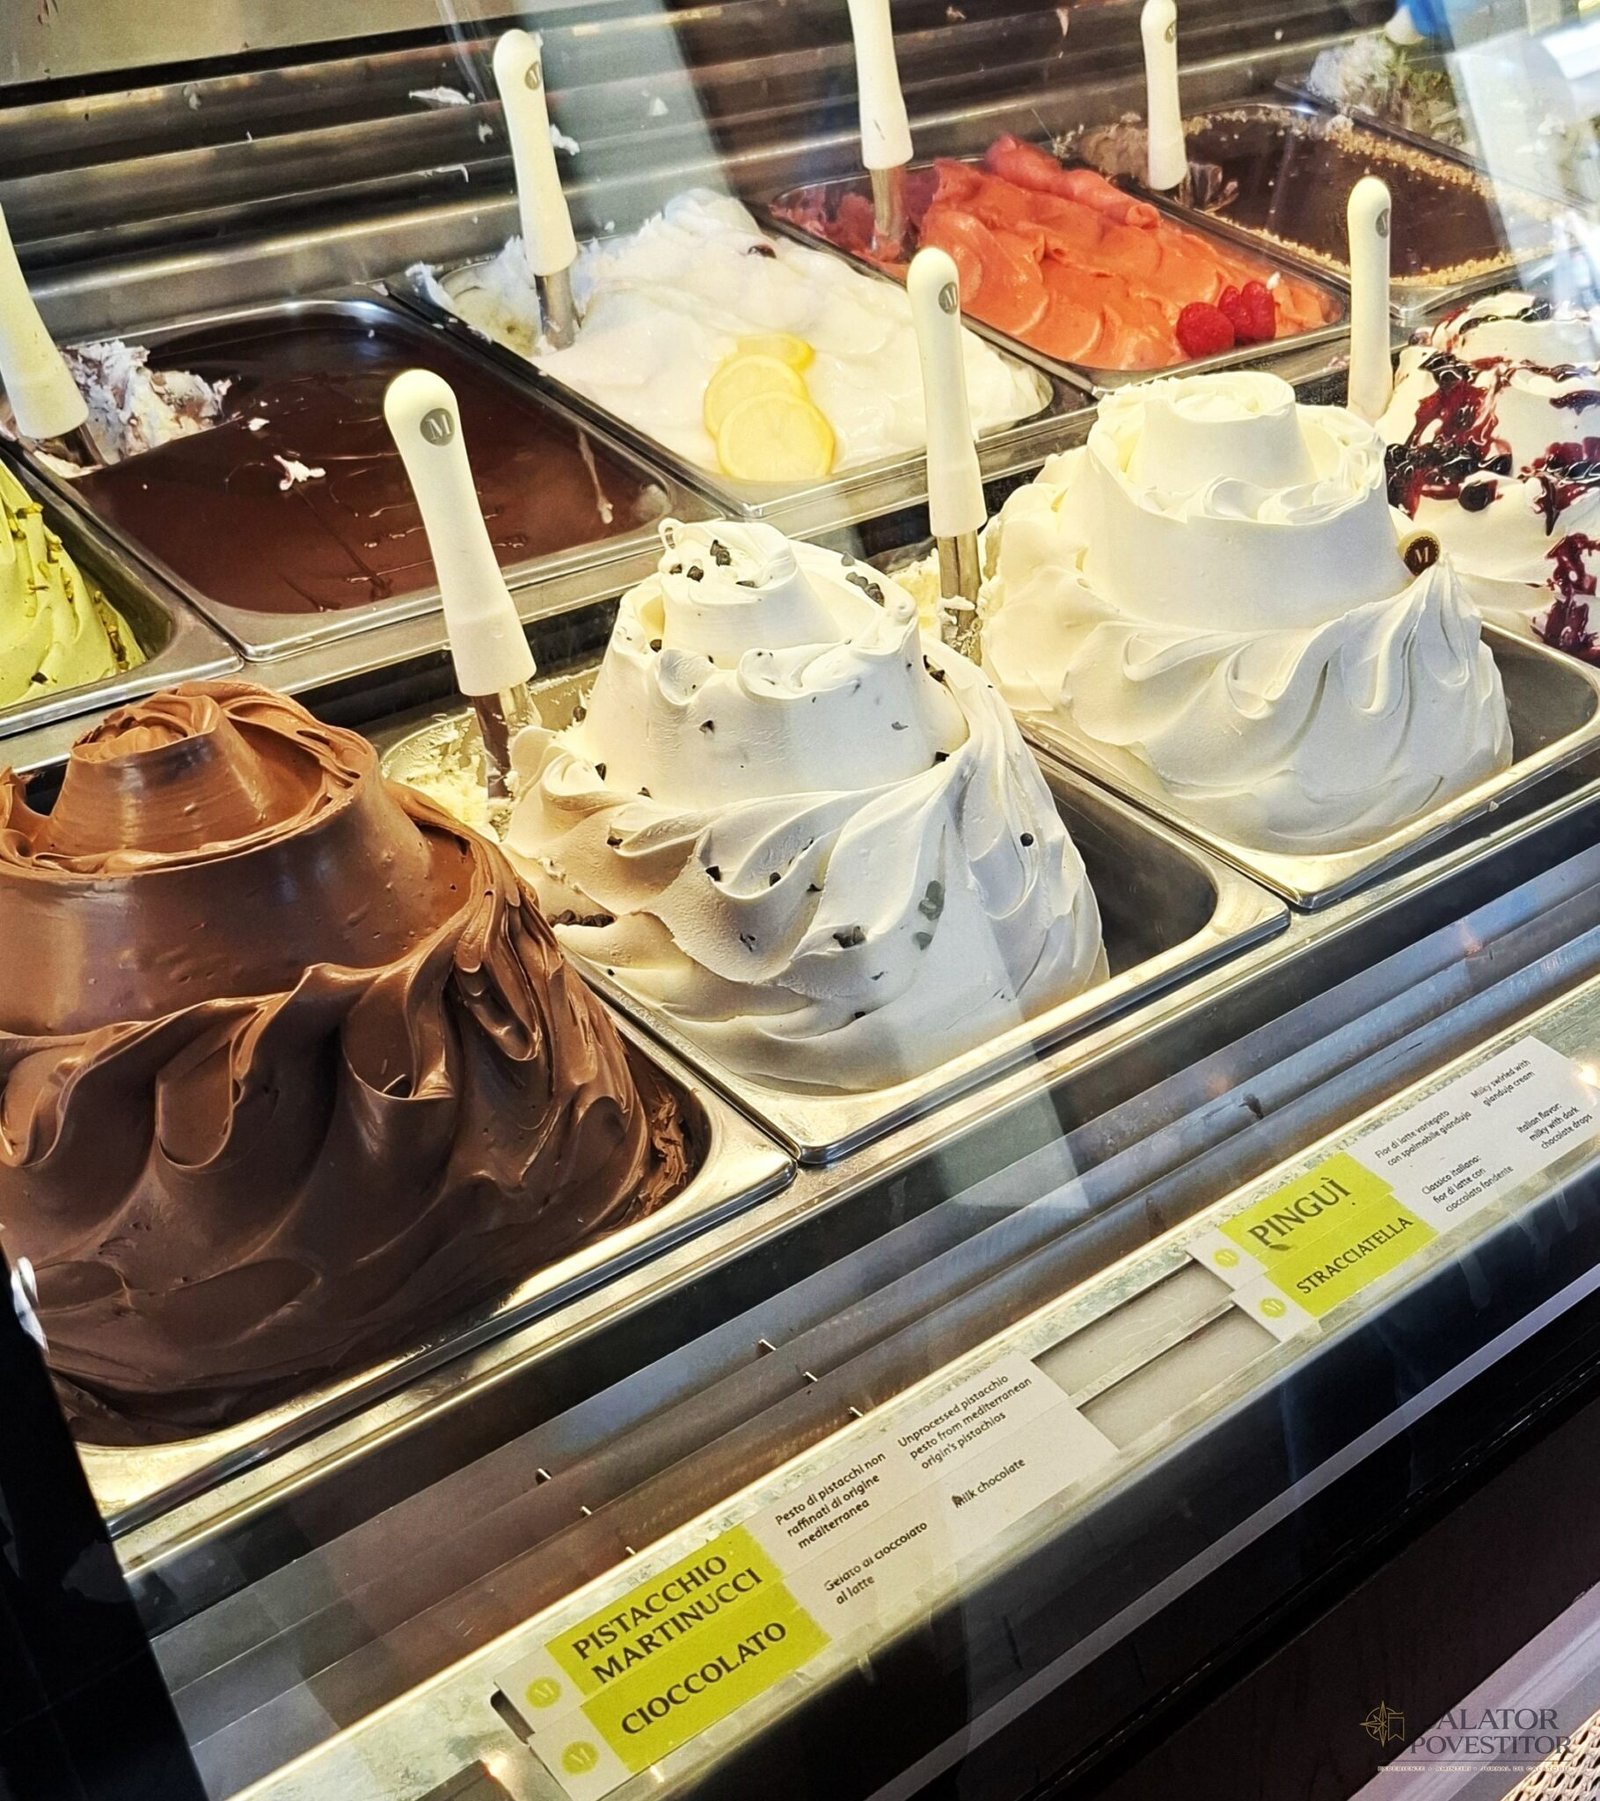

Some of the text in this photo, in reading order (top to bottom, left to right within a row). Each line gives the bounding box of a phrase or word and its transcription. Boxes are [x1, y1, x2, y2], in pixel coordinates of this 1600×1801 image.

[425, 414, 452, 441] M
[1483, 1071, 1535, 1107] gianduja cream
[1491, 1068, 1515, 1087] swirled
[1515, 1059, 1531, 1072] with
[1375, 1110, 1450, 1158] Fior di latte variegato
[1388, 1111, 1471, 1166] con spalmabile gianduja
[1529, 1106, 1580, 1141] milky with dark
[1541, 1114, 1593, 1149] chocolate drops
[1422, 1155, 1481, 1195] Classico italiano:
[1446, 1166, 1514, 1212] cioccolato fondente
[1447, 1186, 1456, 1195] di
[1453, 1177, 1473, 1191] latte
[1472, 1168, 1486, 1179] con
[1248, 1176, 1352, 1247] PINGUÌ
[1296, 1216, 1414, 1294] STRACCIATELLA
[898, 1374, 1009, 1448] Unprocessed pistacchio
[909, 1377, 1032, 1460] pesto from mediterranean
[921, 1411, 1006, 1470] origin's pistachios
[775, 1452, 886, 1526] Pesto di pistacchi non
[787, 1473, 880, 1538] raffinati di origine
[952, 1458, 1026, 1509] Milk chocolate
[798, 1498, 870, 1549] mediterranea
[571, 1555, 728, 1660] PISTACCHIO
[836, 1574, 875, 1605] al latte
[591, 1567, 763, 1684] MARTINUCCI
[621, 1621, 787, 1735] CIOCCOLATO
